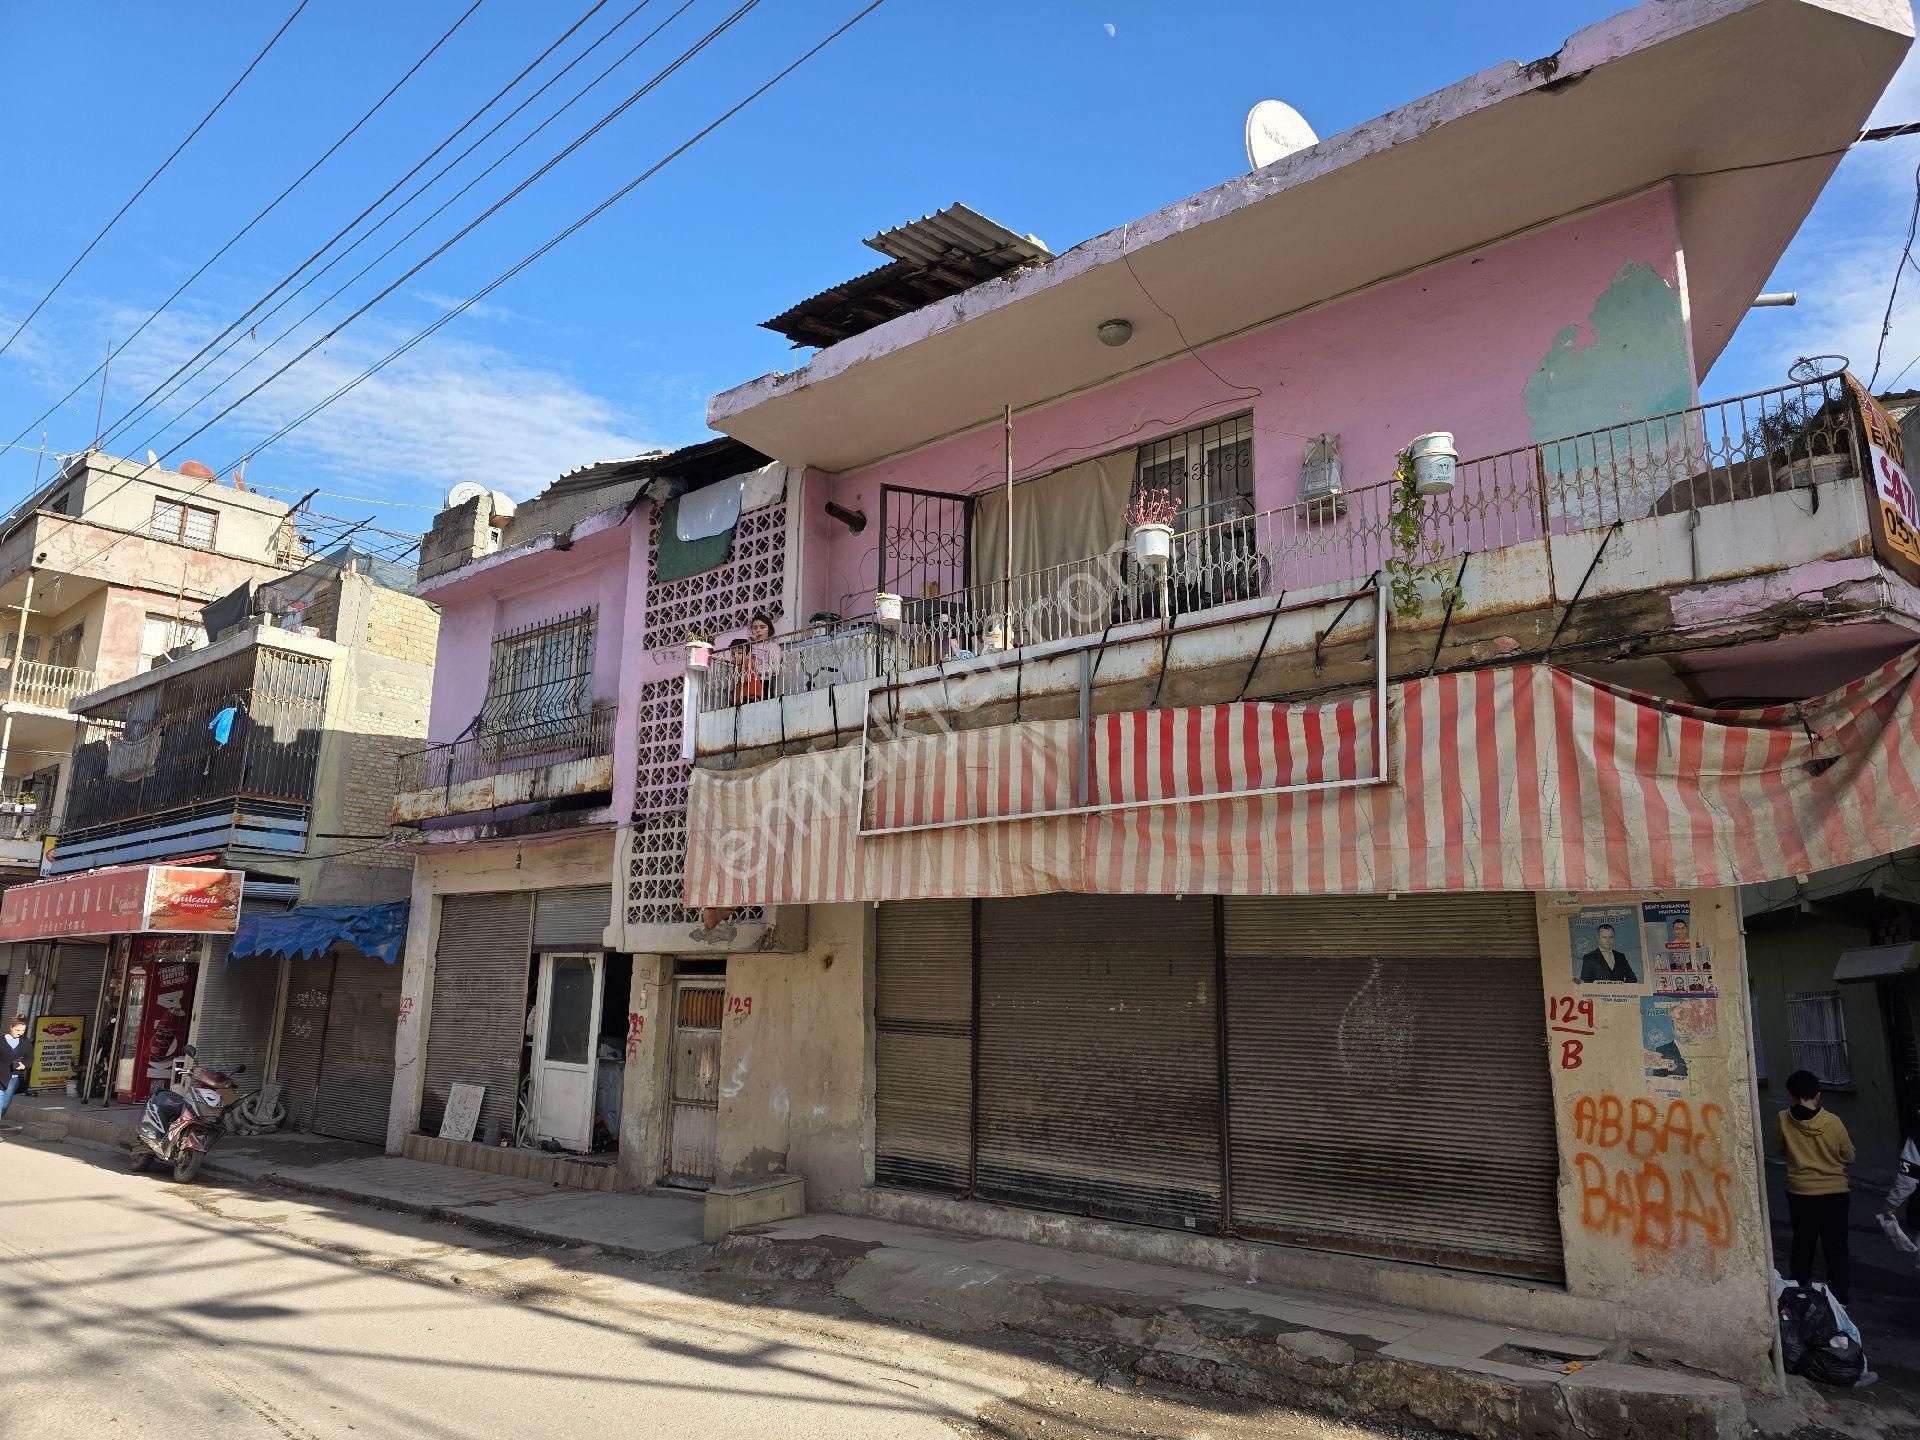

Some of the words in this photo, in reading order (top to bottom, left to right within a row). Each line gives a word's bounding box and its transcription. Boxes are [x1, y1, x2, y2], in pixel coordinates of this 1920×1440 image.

[21, 884, 115, 921] GÜLCANLI
[727, 996, 753, 1016] 129
[1549, 996, 1595, 1029] 129
[1561, 1038, 1584, 1071] B
[1574, 1094, 1727, 1168] ABBAS
[1575, 1153, 1734, 1249] BABAS
